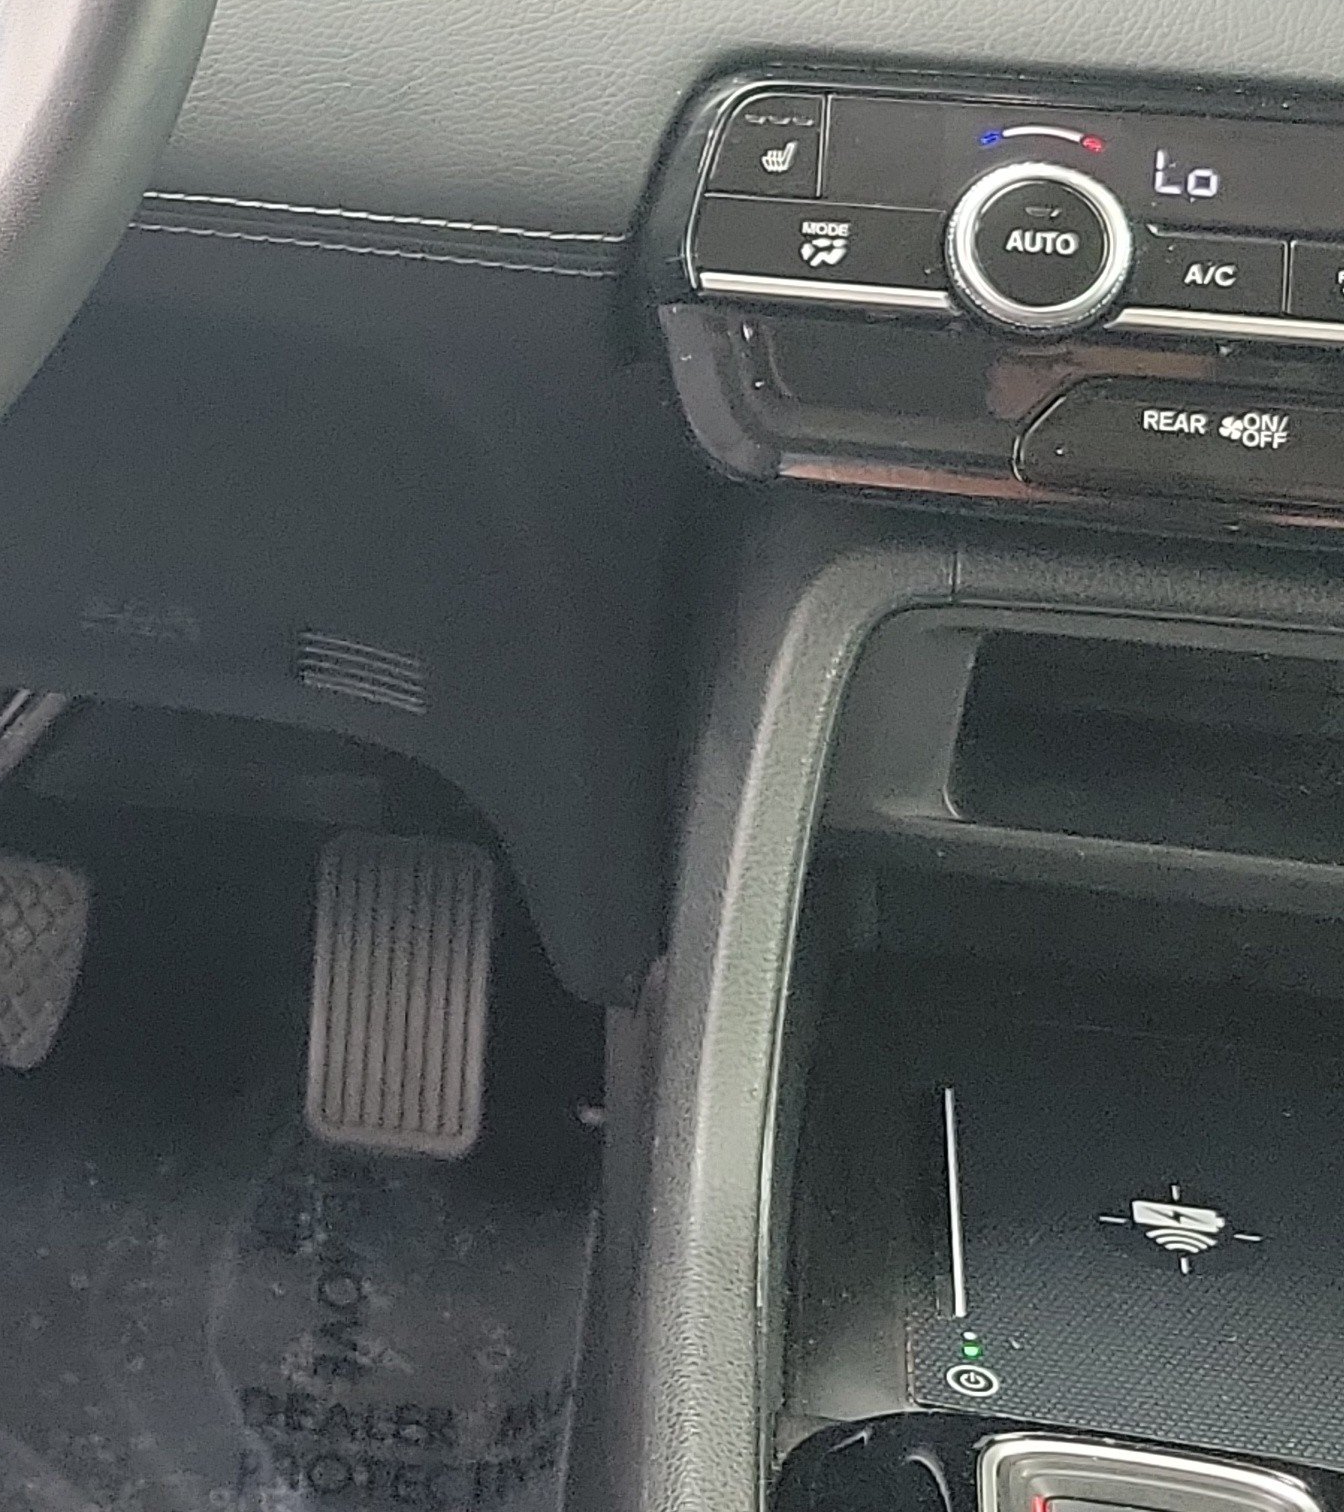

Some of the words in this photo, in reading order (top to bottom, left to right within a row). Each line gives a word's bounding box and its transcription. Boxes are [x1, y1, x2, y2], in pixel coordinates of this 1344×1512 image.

[802, 221, 850, 237] MODE
[1006, 230, 1078, 254] AUTO
[1184, 264, 1237, 287] A/C
[1143, 409, 1207, 434] REAR
[1243, 411, 1289, 431] ON/
[1242, 430, 1288, 449] OFF
